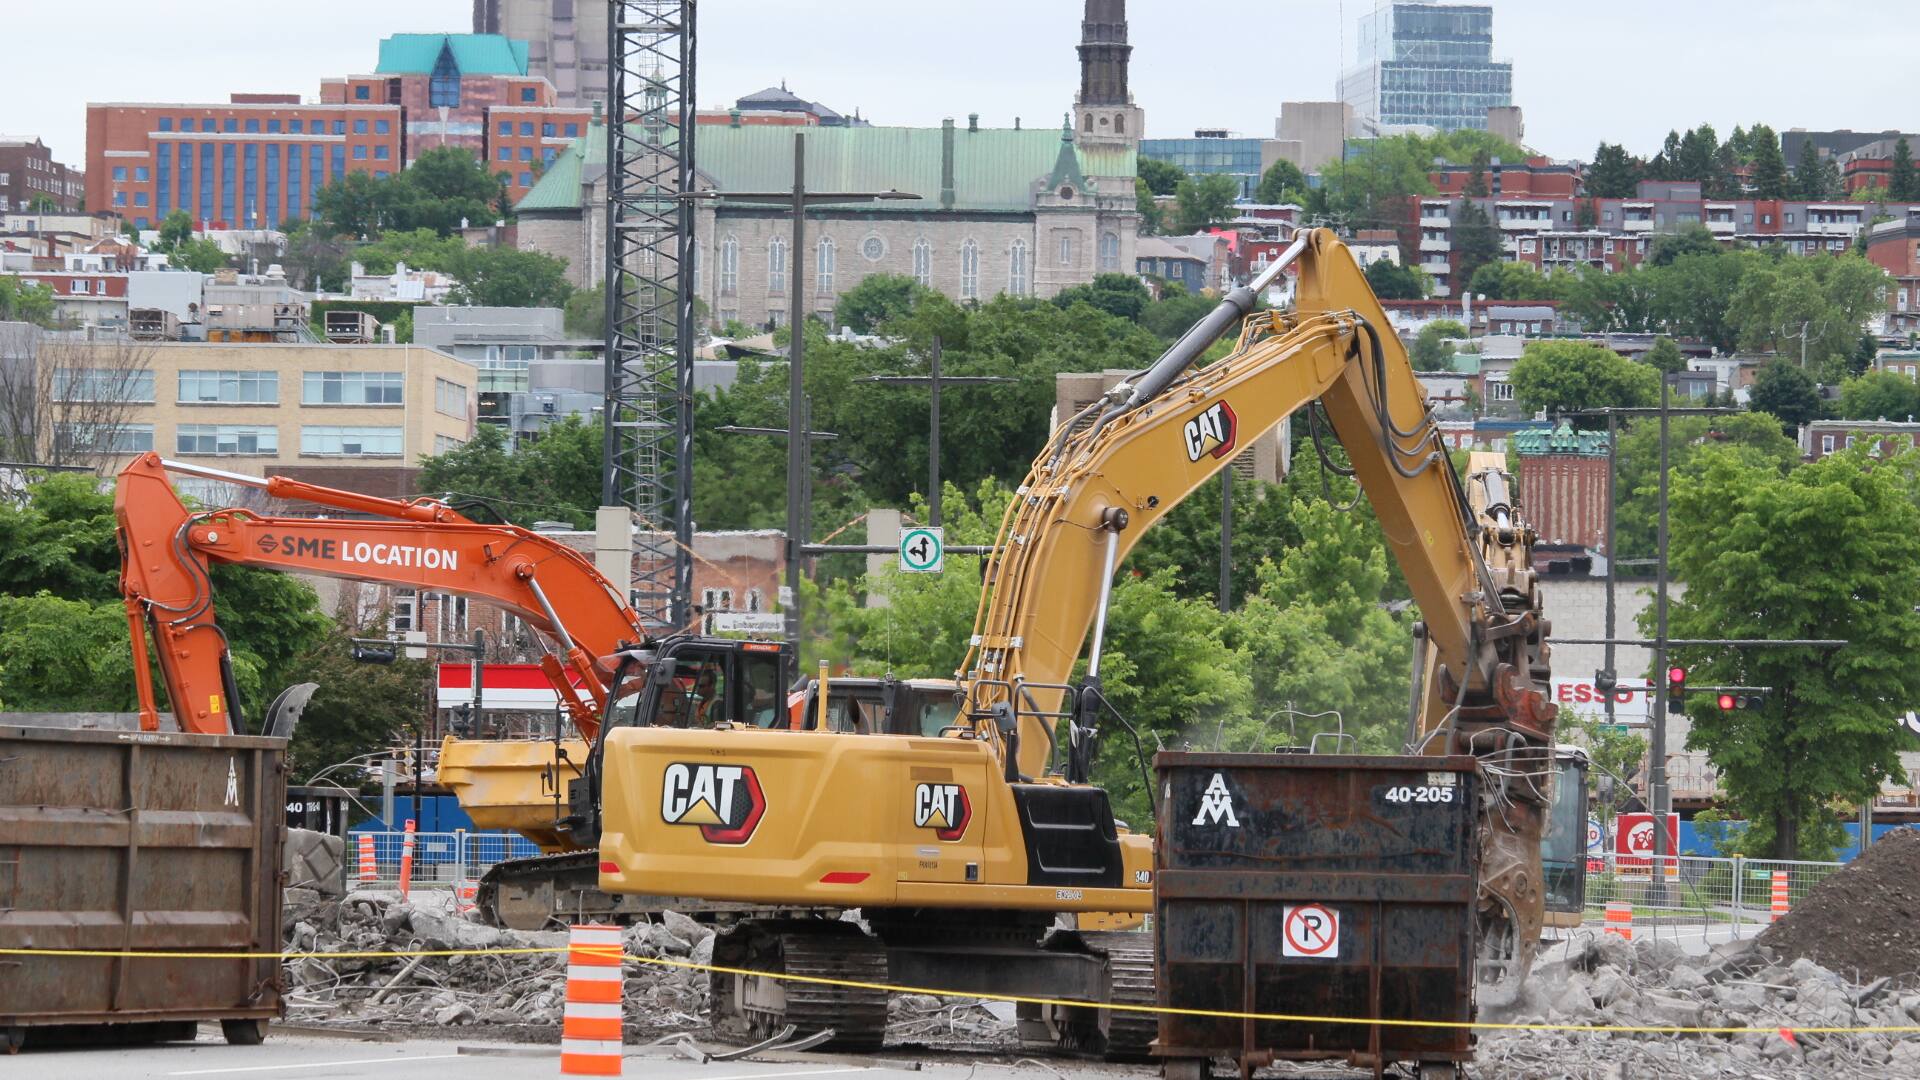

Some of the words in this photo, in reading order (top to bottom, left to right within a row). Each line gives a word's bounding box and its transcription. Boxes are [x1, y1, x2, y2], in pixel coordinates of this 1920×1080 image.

[1184, 403, 1224, 461] CAT
[281, 536, 336, 560] SME
[342, 541, 458, 570] LOCATION
[662, 763, 742, 825] CAT
[915, 783, 959, 828] CAT
[1385, 786, 1453, 802] 40-205
[1135, 871, 1150, 883] 340
